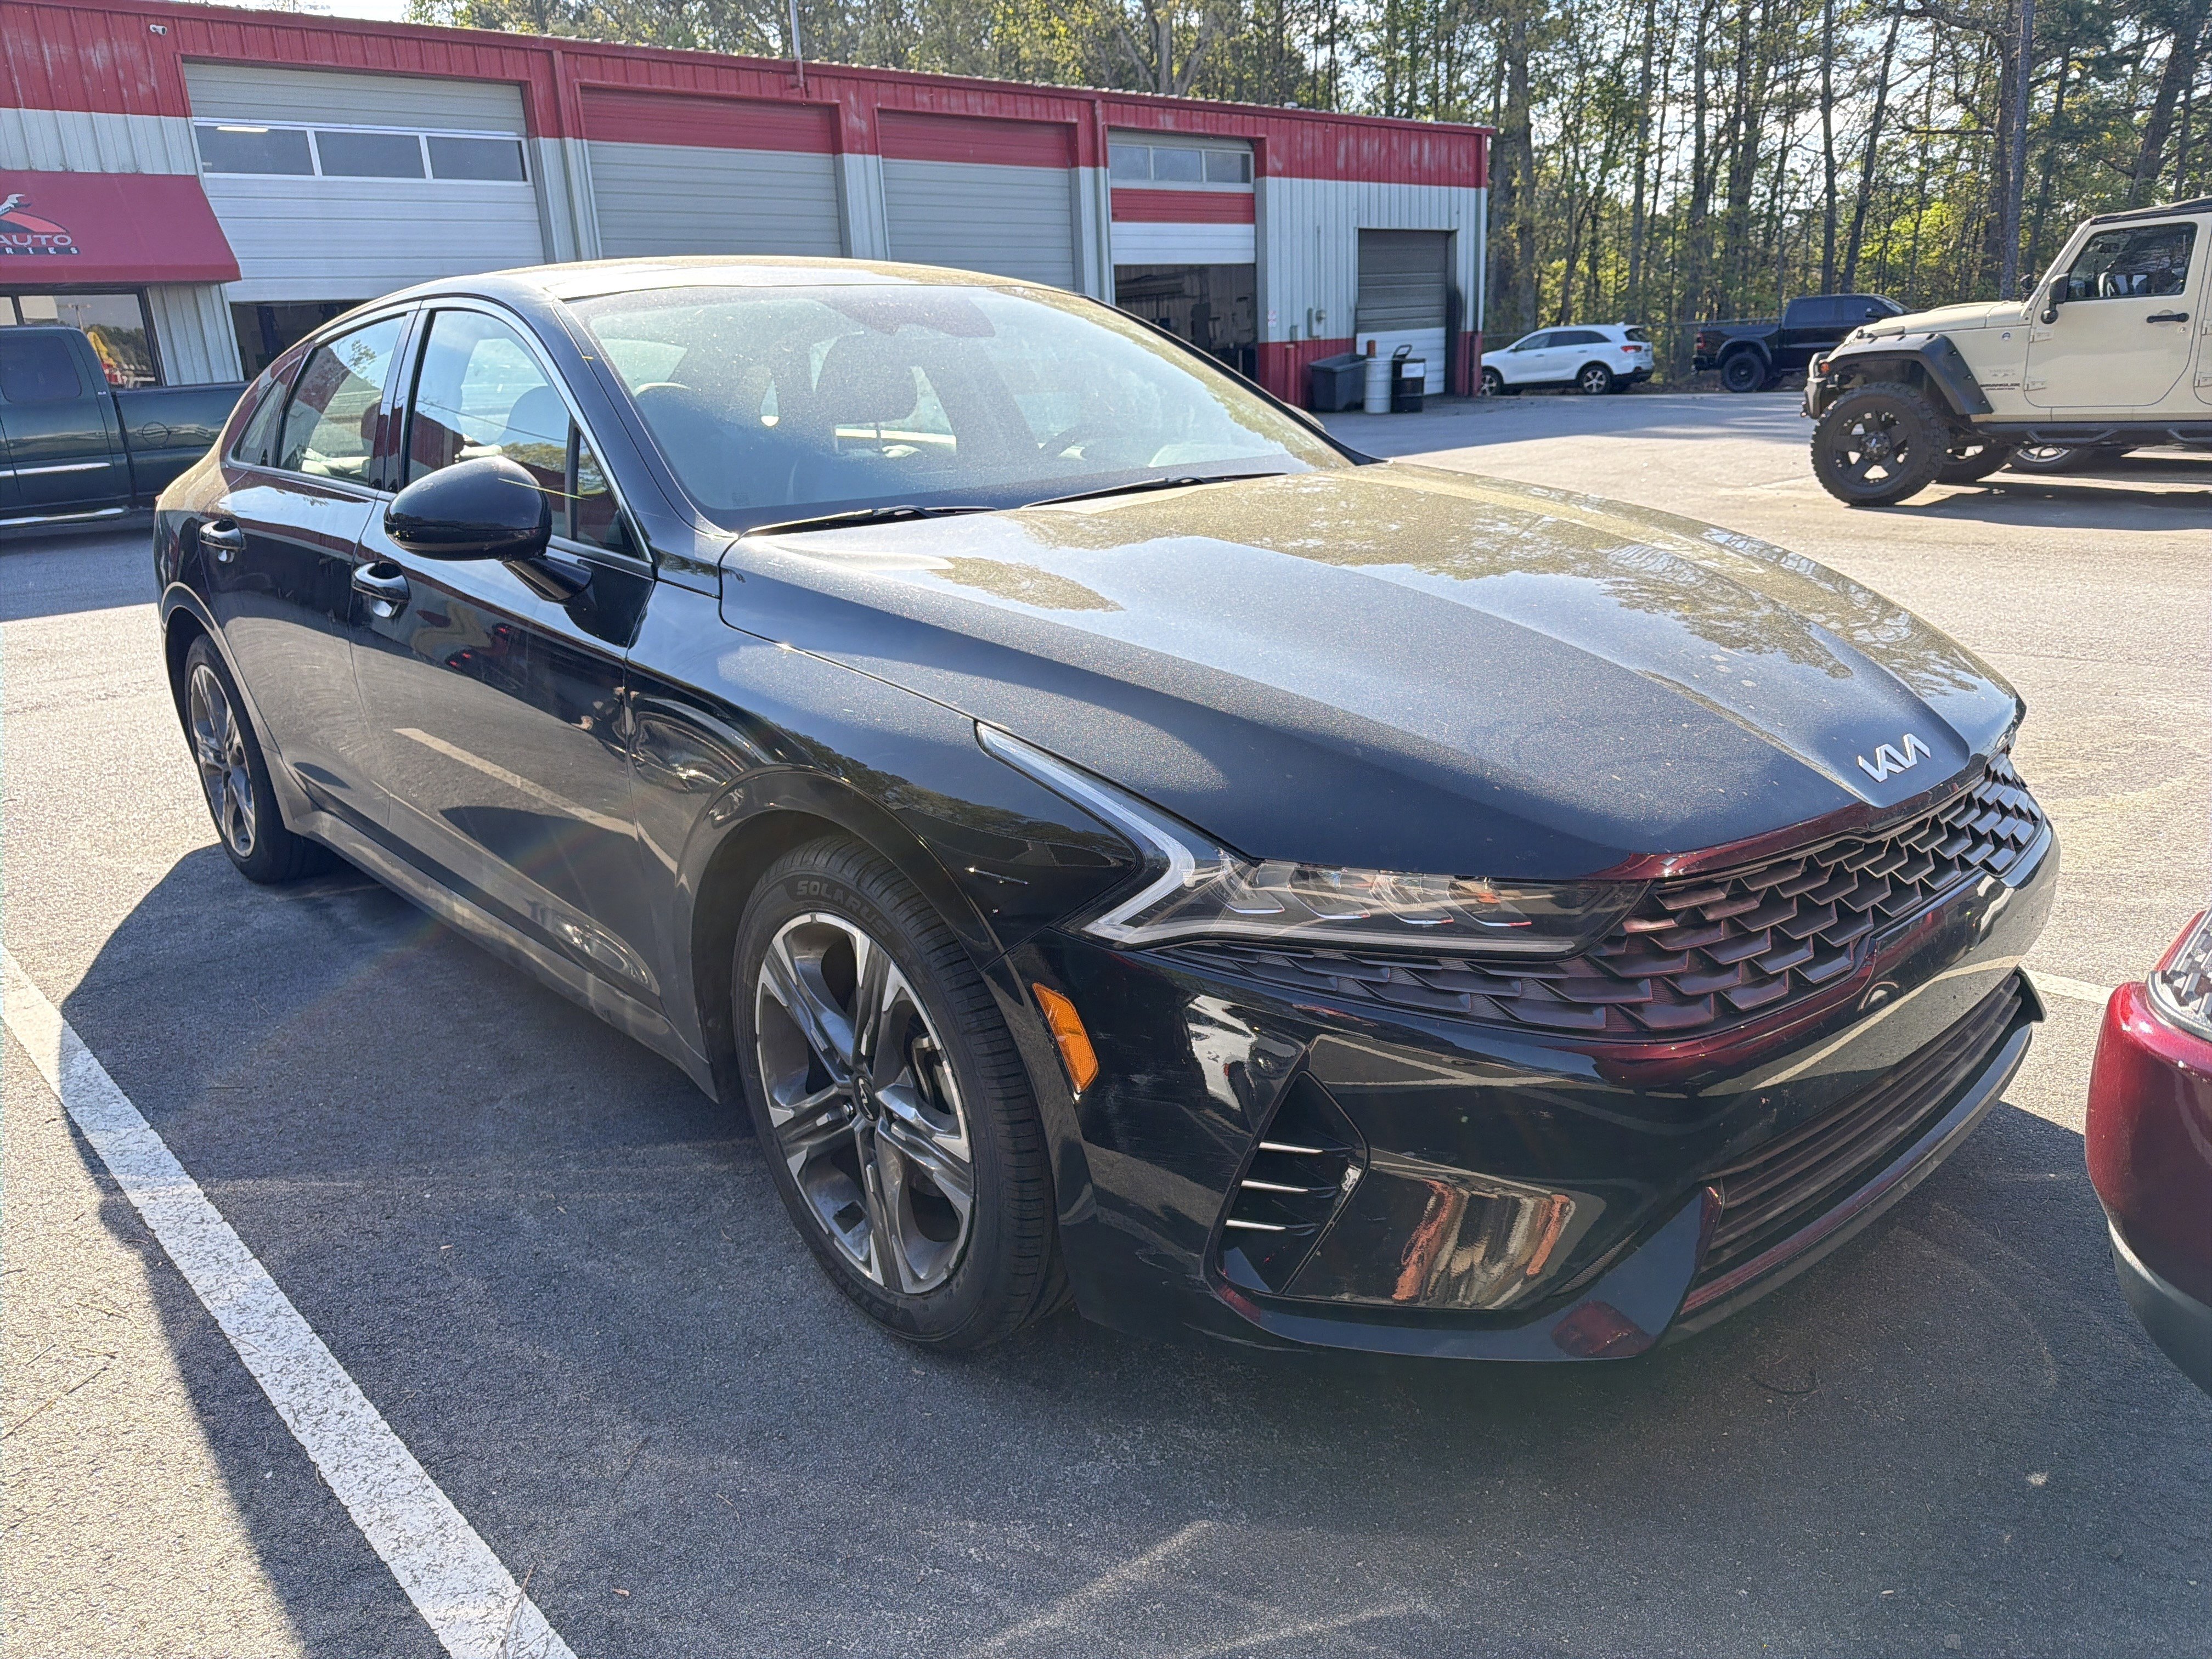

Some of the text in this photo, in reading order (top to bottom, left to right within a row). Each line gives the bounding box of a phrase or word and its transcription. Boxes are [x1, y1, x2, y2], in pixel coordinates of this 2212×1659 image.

[0, 235, 72, 246] AUTO
[1857, 733, 1932, 783] KIA
[796, 880, 892, 937] SOLARUS
